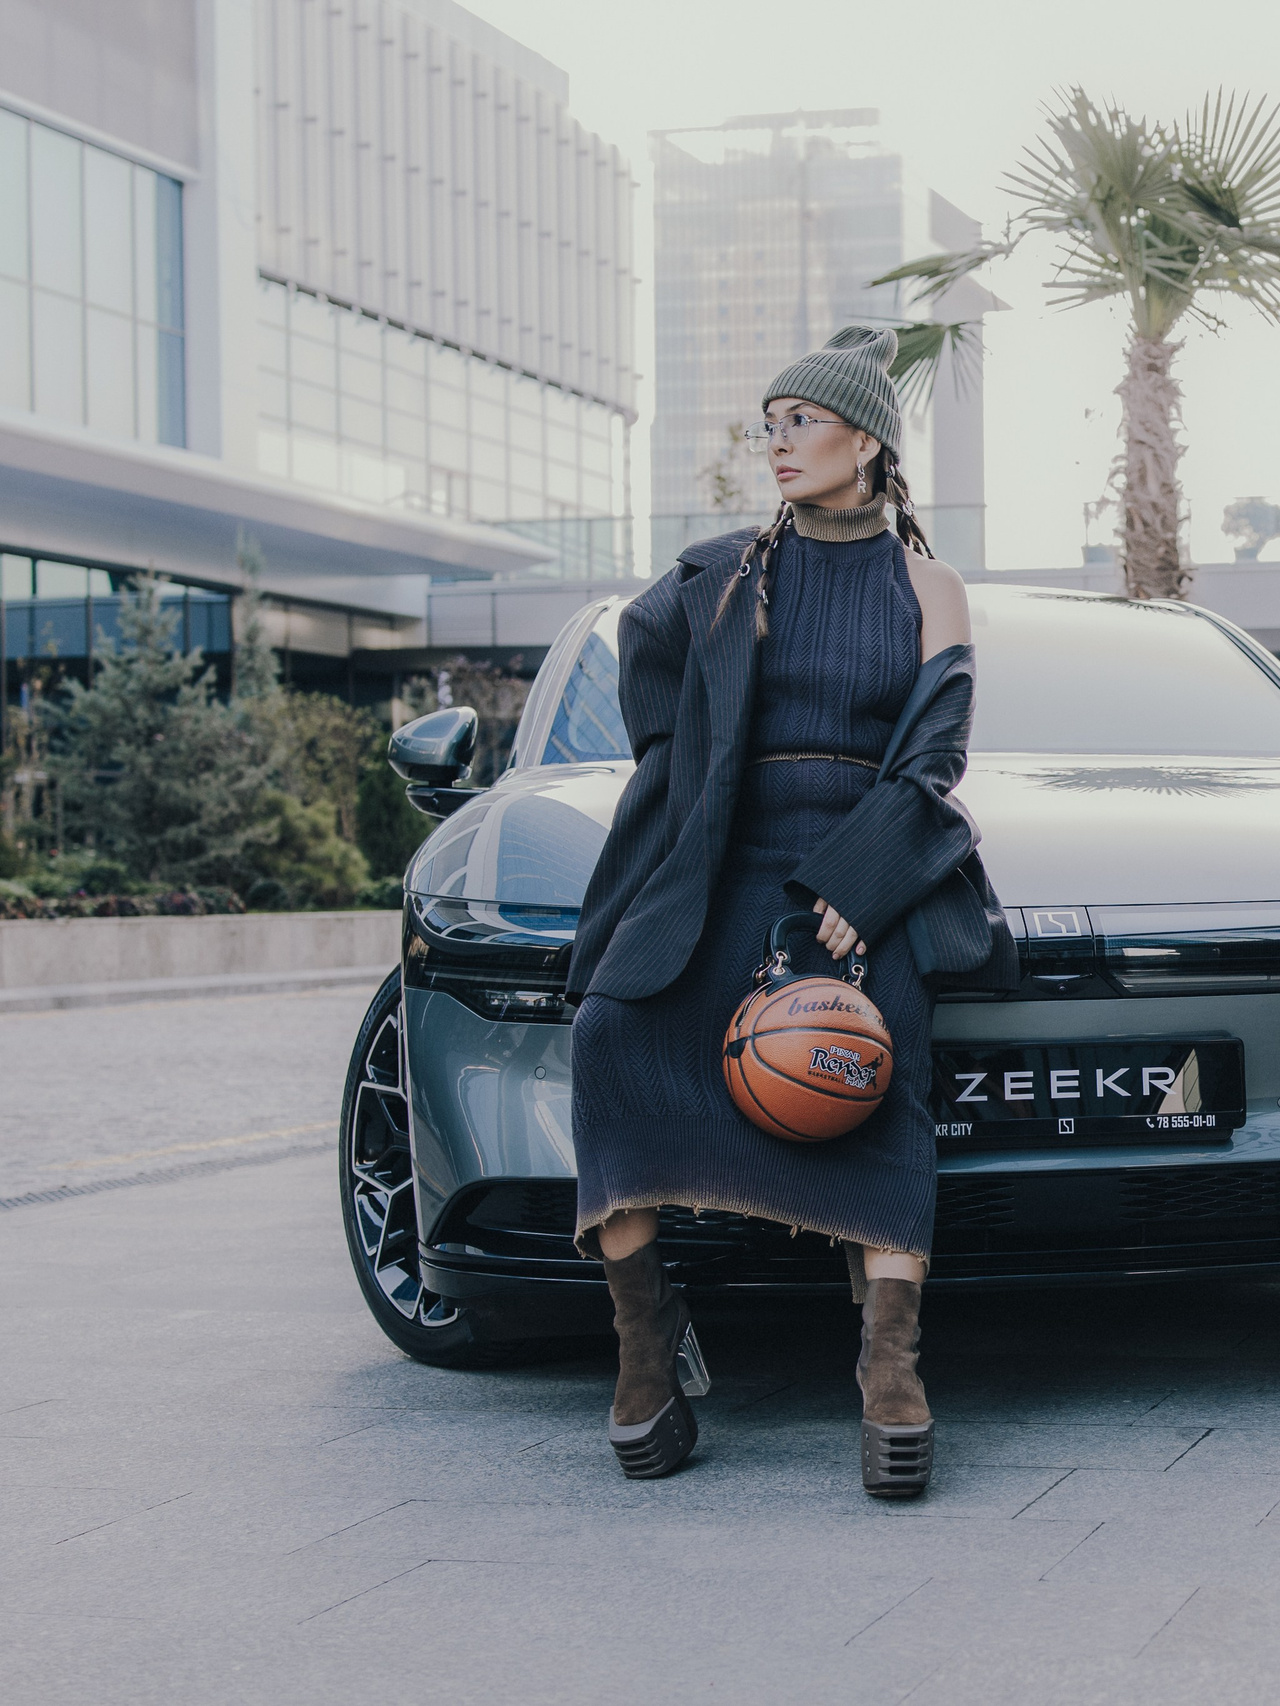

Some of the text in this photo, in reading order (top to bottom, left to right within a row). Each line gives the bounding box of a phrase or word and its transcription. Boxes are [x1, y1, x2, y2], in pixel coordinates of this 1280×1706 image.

[857, 481, 867, 494] R
[829, 1045, 861, 1062] PIXAR
[809, 1047, 876, 1083] Render
[844, 1076, 867, 1090] MAN
[954, 1066, 1178, 1102] ZEEKR
[1156, 1114, 1216, 1129] 78 555-01-01
[950, 1123, 973, 1136] CITY
